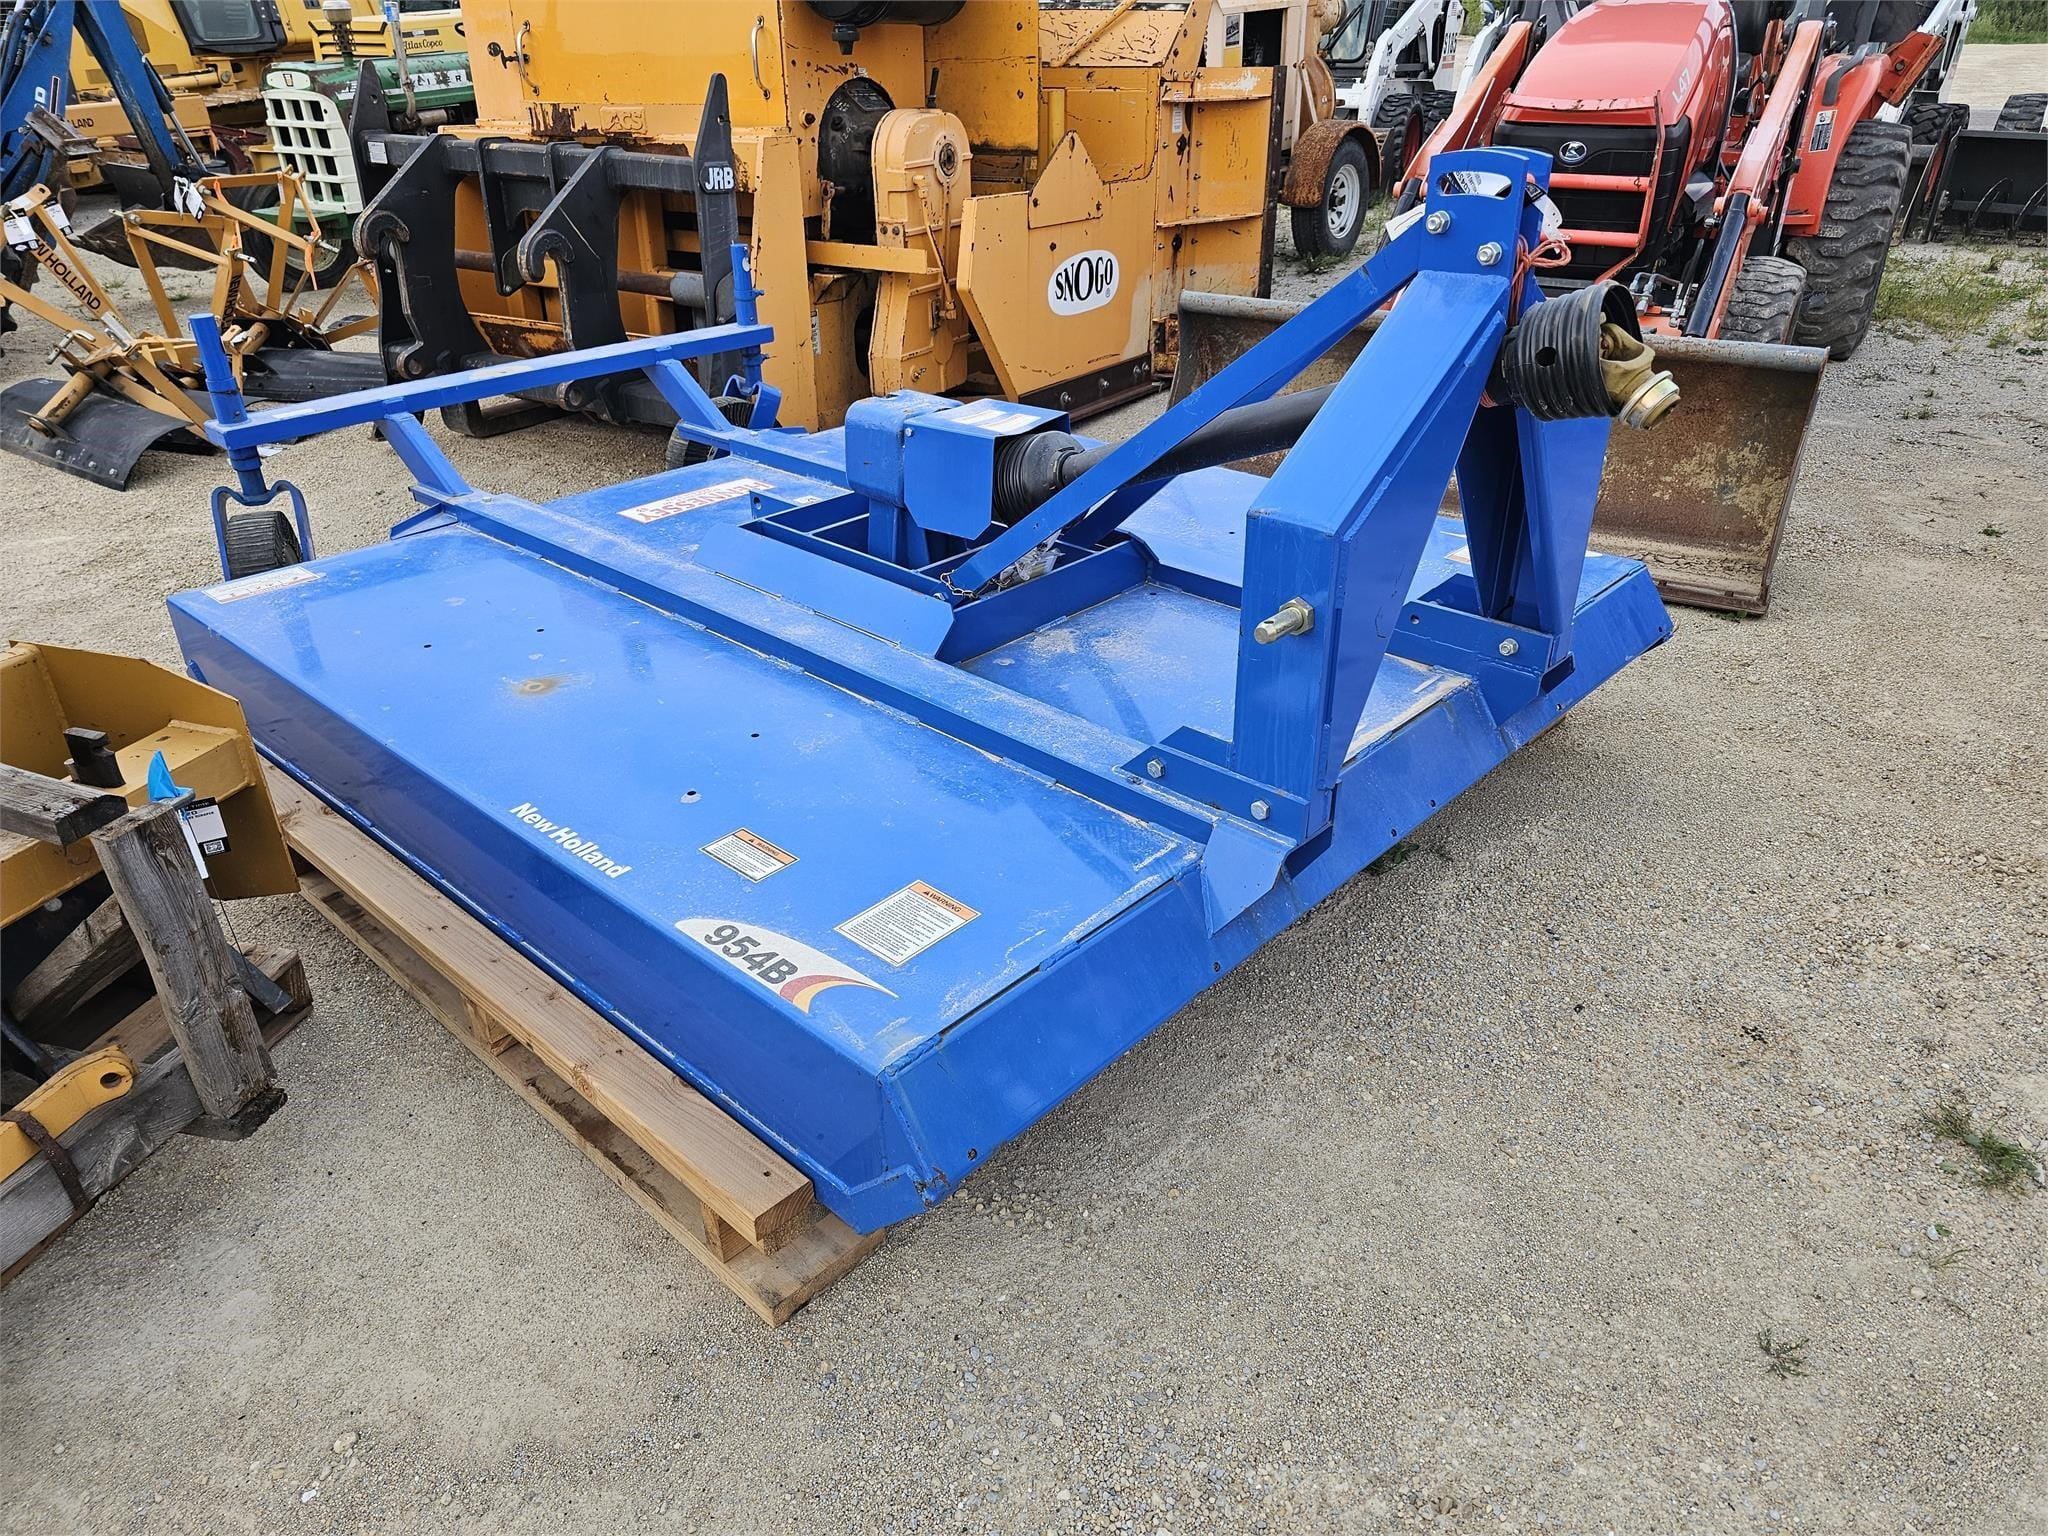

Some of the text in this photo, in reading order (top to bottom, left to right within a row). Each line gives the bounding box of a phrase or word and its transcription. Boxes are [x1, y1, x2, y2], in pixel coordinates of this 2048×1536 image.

[423, 39, 443, 49] Copco
[608, 111, 644, 131] ACS
[704, 166, 735, 190] JRB
[44, 255, 102, 311] HOLLAND
[1054, 256, 1114, 302] SNOGO
[508, 802, 633, 879] New Holland
[929, 892, 962, 913] WARNING
[703, 924, 799, 985] 954B
